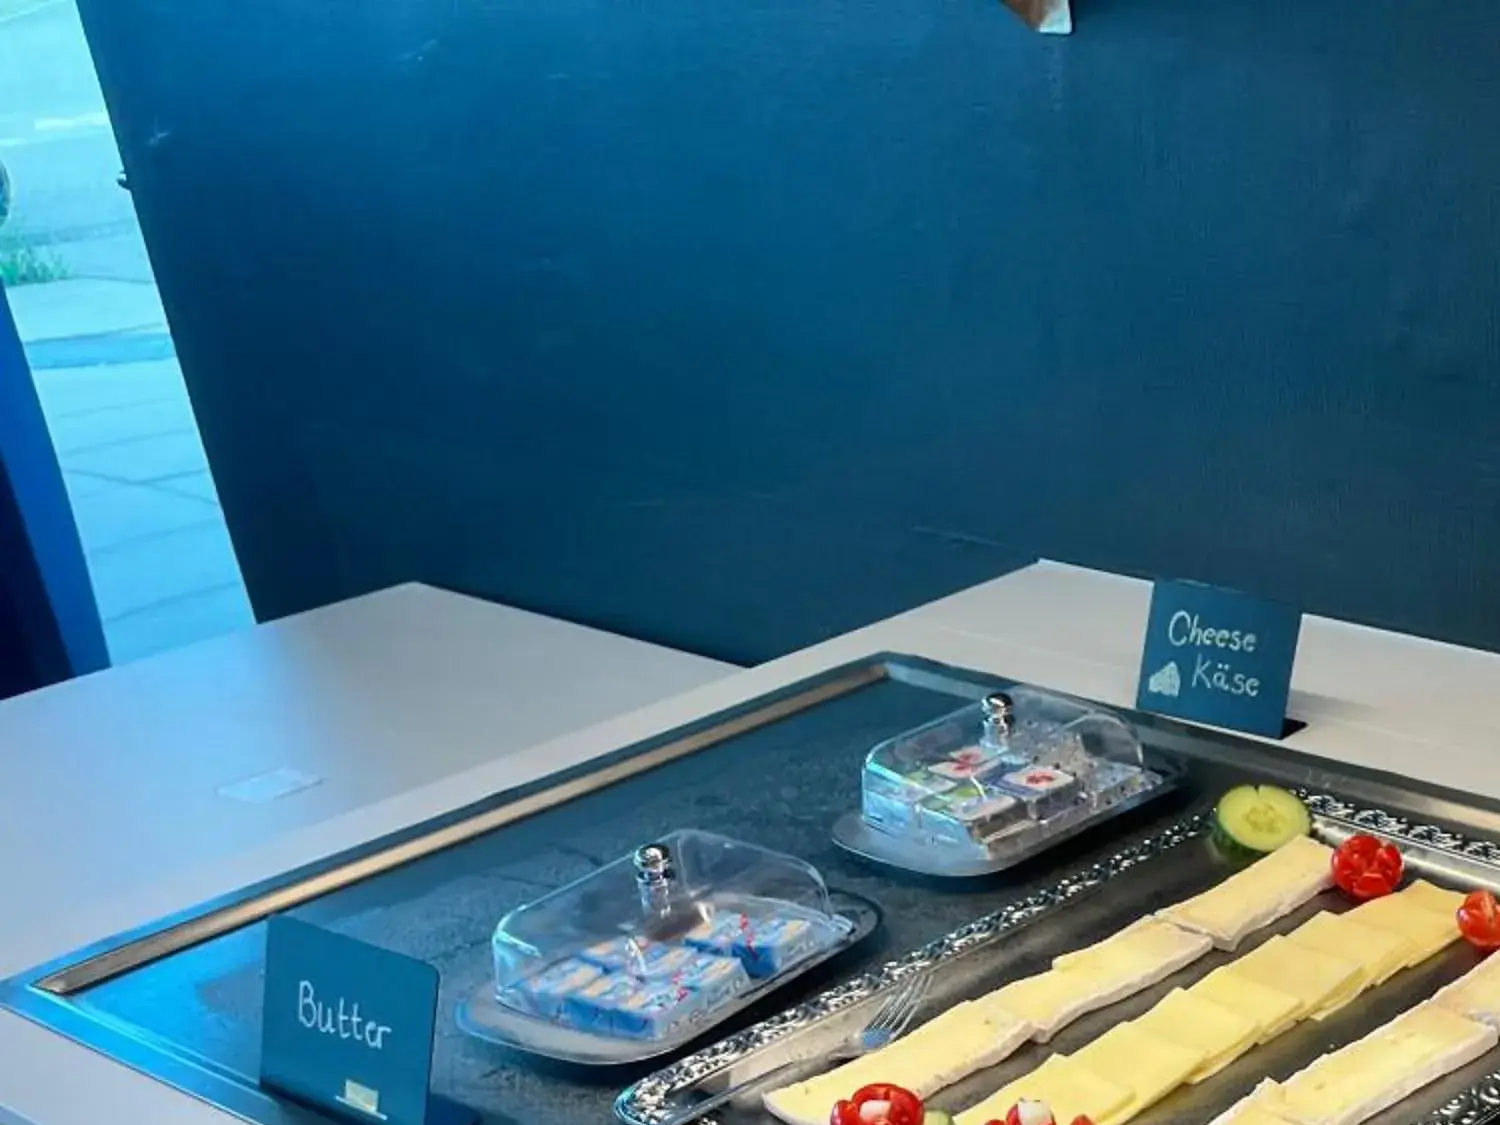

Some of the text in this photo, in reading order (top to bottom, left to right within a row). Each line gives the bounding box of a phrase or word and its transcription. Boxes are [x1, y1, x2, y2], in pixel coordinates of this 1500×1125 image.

[1168, 609, 1257, 652] Cheese
[1192, 653, 1261, 697] Käse
[299, 979, 392, 1049] Butter
